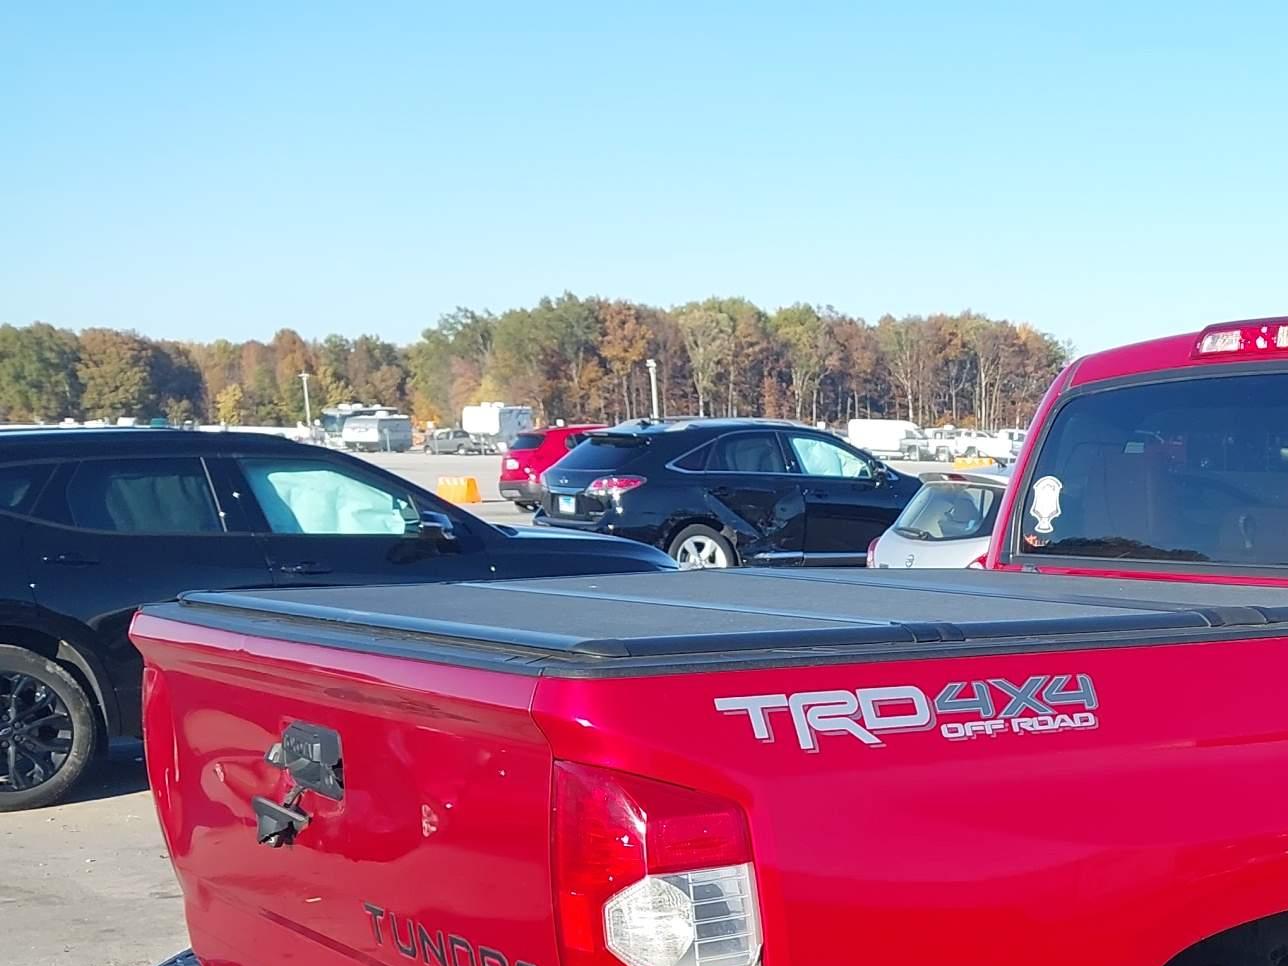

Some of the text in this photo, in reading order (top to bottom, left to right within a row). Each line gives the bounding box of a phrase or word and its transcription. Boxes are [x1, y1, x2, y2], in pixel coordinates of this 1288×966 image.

[714, 673, 1099, 753] TRD 4X4
[940, 712, 1098, 740] OFF ROAD
